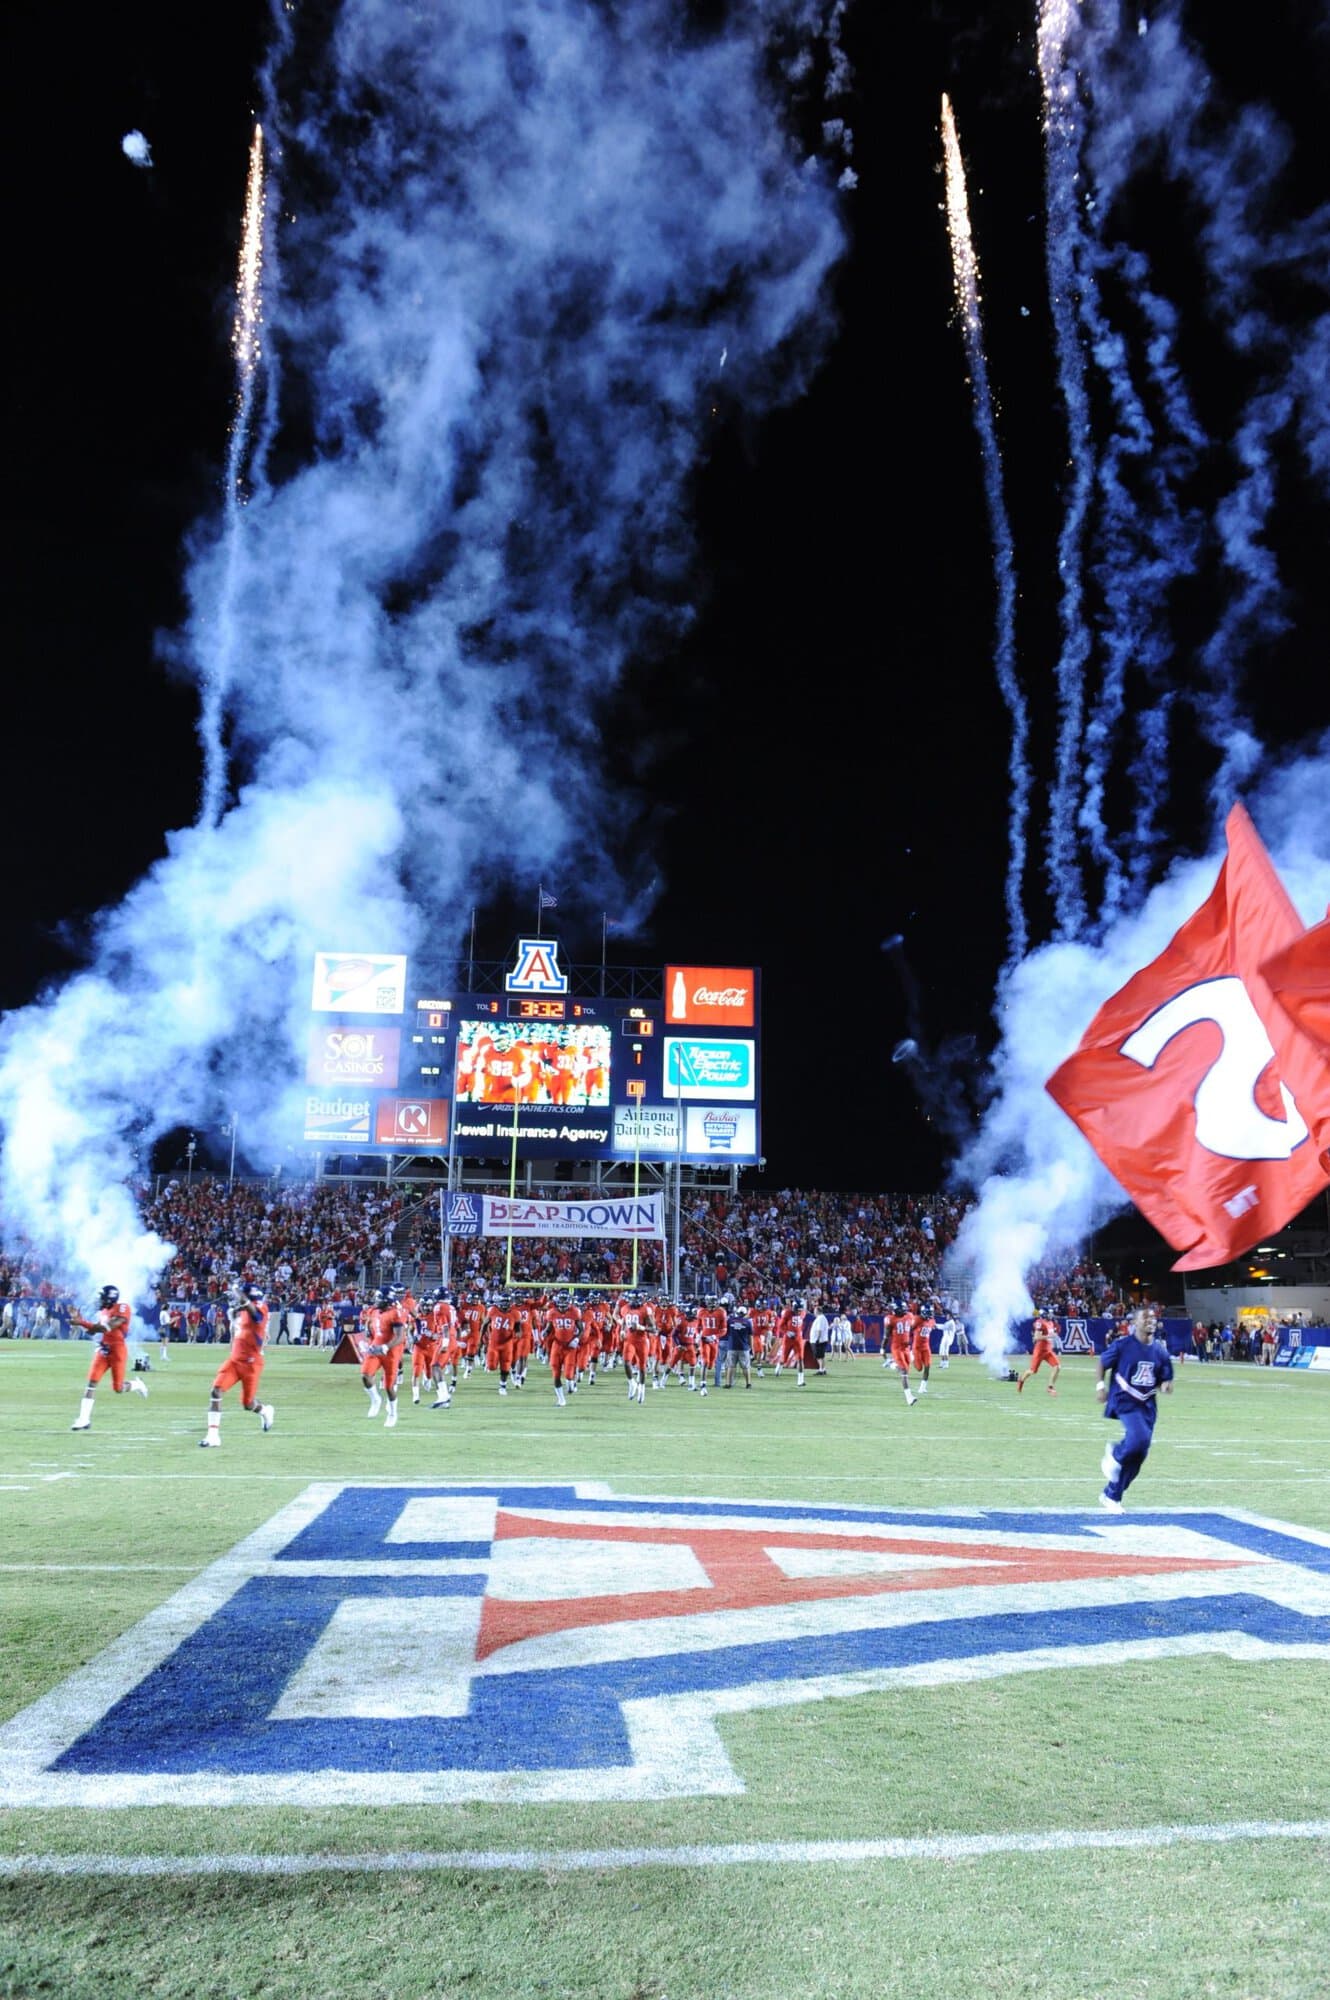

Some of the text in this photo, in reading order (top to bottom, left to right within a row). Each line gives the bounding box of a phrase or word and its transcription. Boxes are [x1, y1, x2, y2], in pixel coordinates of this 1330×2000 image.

[505, 940, 568, 993] A
[490, 1002, 498, 1013] 3
[520, 1001, 564, 1017] 3:32
[573, 1005, 582, 1016] 3
[325, 1032, 384, 1062] SOL
[689, 1046, 731, 1059] Tucson
[323, 1062, 384, 1074] CASINOS
[693, 1059, 742, 1071] Electric
[697, 1071, 742, 1082] Power
[305, 1097, 371, 1118] Budget
[402, 1105, 425, 1132] K
[454, 1123, 608, 1142] Jewell Insurance Agency
[615, 1123, 650, 1139] Daily
[448, 1194, 478, 1222] A
[566, 1203, 655, 1226] DOWN
[448, 1224, 477, 1233] CLUB
[705, 1317, 716, 1329] 11
[1061, 1319, 1095, 1352] A
[1131, 1361, 1156, 1387] A
